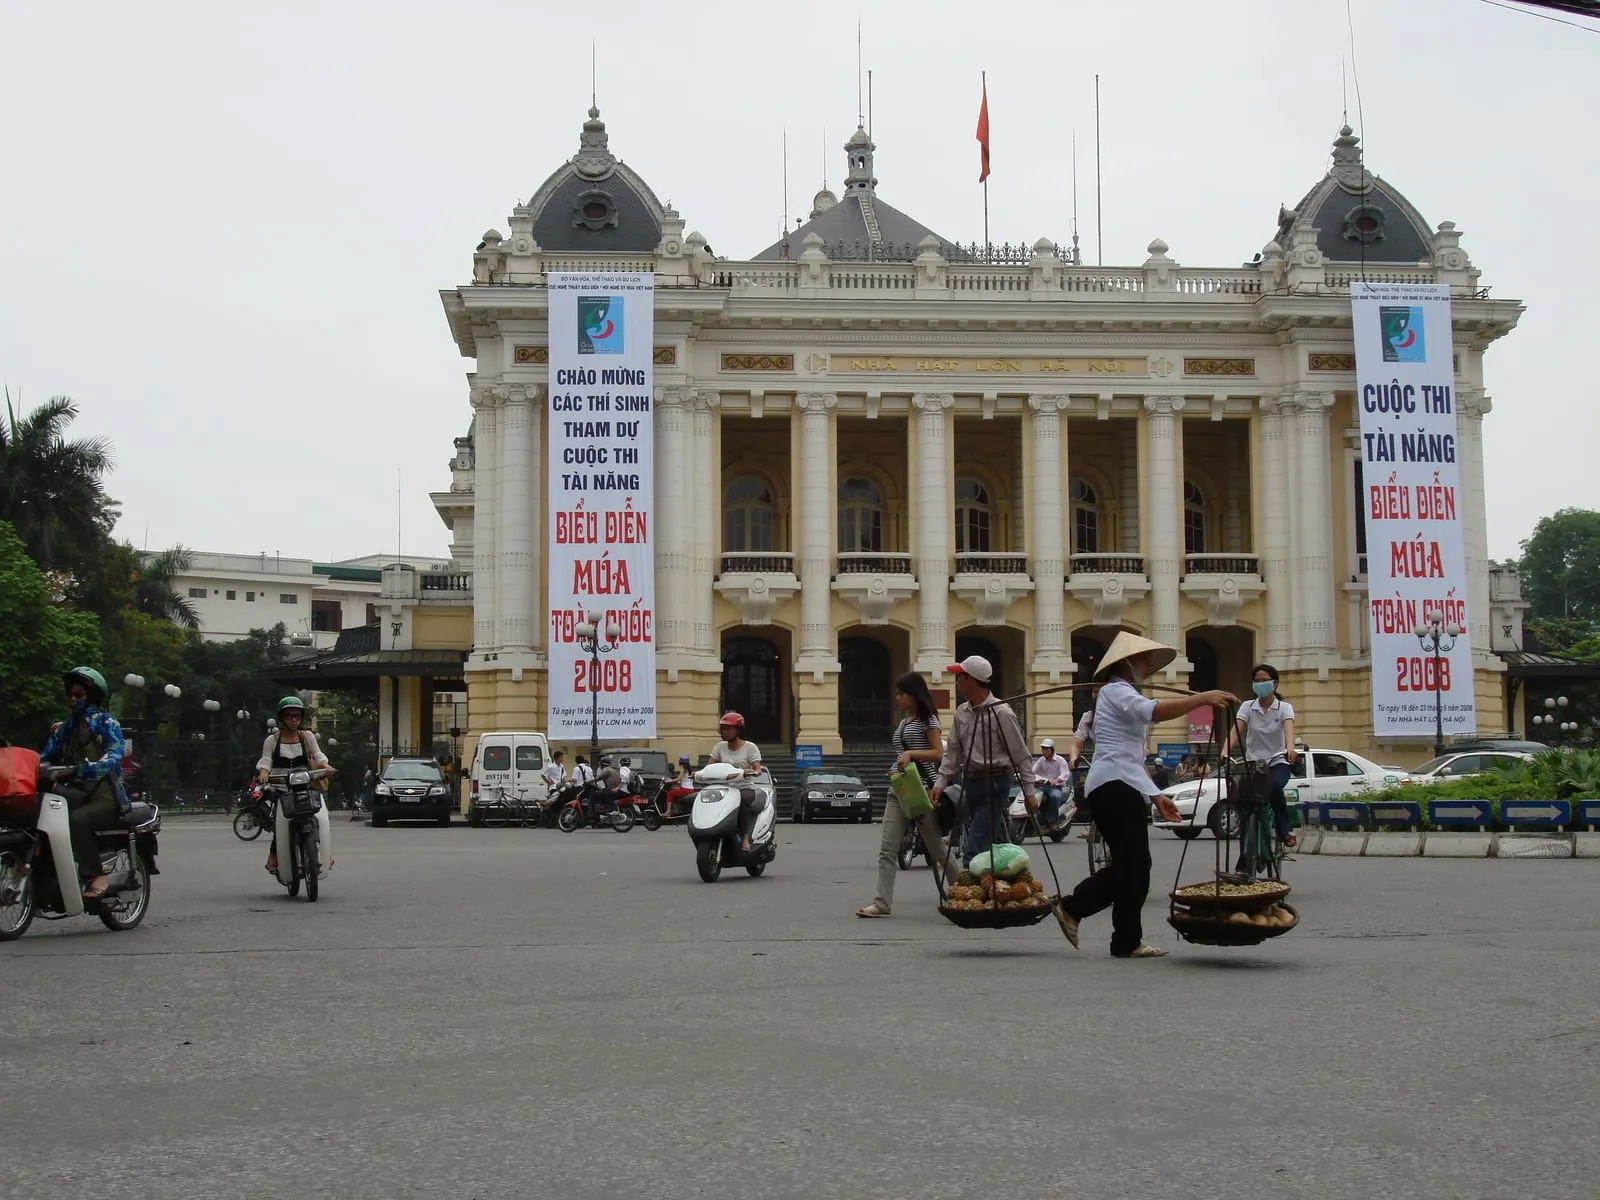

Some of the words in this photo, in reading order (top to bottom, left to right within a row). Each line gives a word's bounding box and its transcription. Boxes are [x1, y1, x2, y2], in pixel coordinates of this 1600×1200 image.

[556, 366, 597, 386] CHÀO
[601, 365, 645, 386] MỪNG
[851, 357, 897, 371] NHÀ
[552, 392, 583, 412] CÁC
[587, 391, 610, 412] THÍ
[615, 395, 650, 412] SINH
[1363, 378, 1416, 420] CUỘC
[1421, 385, 1451, 414] THI
[563, 421, 611, 438] THAM
[616, 420, 640, 441] DỰ
[1363, 426, 1396, 462] TÀI
[1401, 427, 1456, 463] NĂNG
[563, 444, 608, 468] CUỘC
[613, 447, 638, 464] THI
[562, 470, 588, 491] TÀI
[593, 470, 640, 491] NĂNG
[1370, 471, 1411, 520] BIỂU
[1416, 470, 1456, 520] DIỄN
[556, 497, 598, 544] BIỂU
[605, 496, 647, 544] DIỄN
[572, 550, 632, 595] MÚA
[1390, 532, 1445, 578] MÚA
[551, 601, 599, 643] TOÀ
[1371, 590, 1417, 634] TOÀN
[574, 659, 632, 693] 2008
[1396, 656, 1451, 692] 2008
[577, 707, 584, 715] 19
[598, 707, 605, 715] 23
[622, 706, 627, 715] 5
